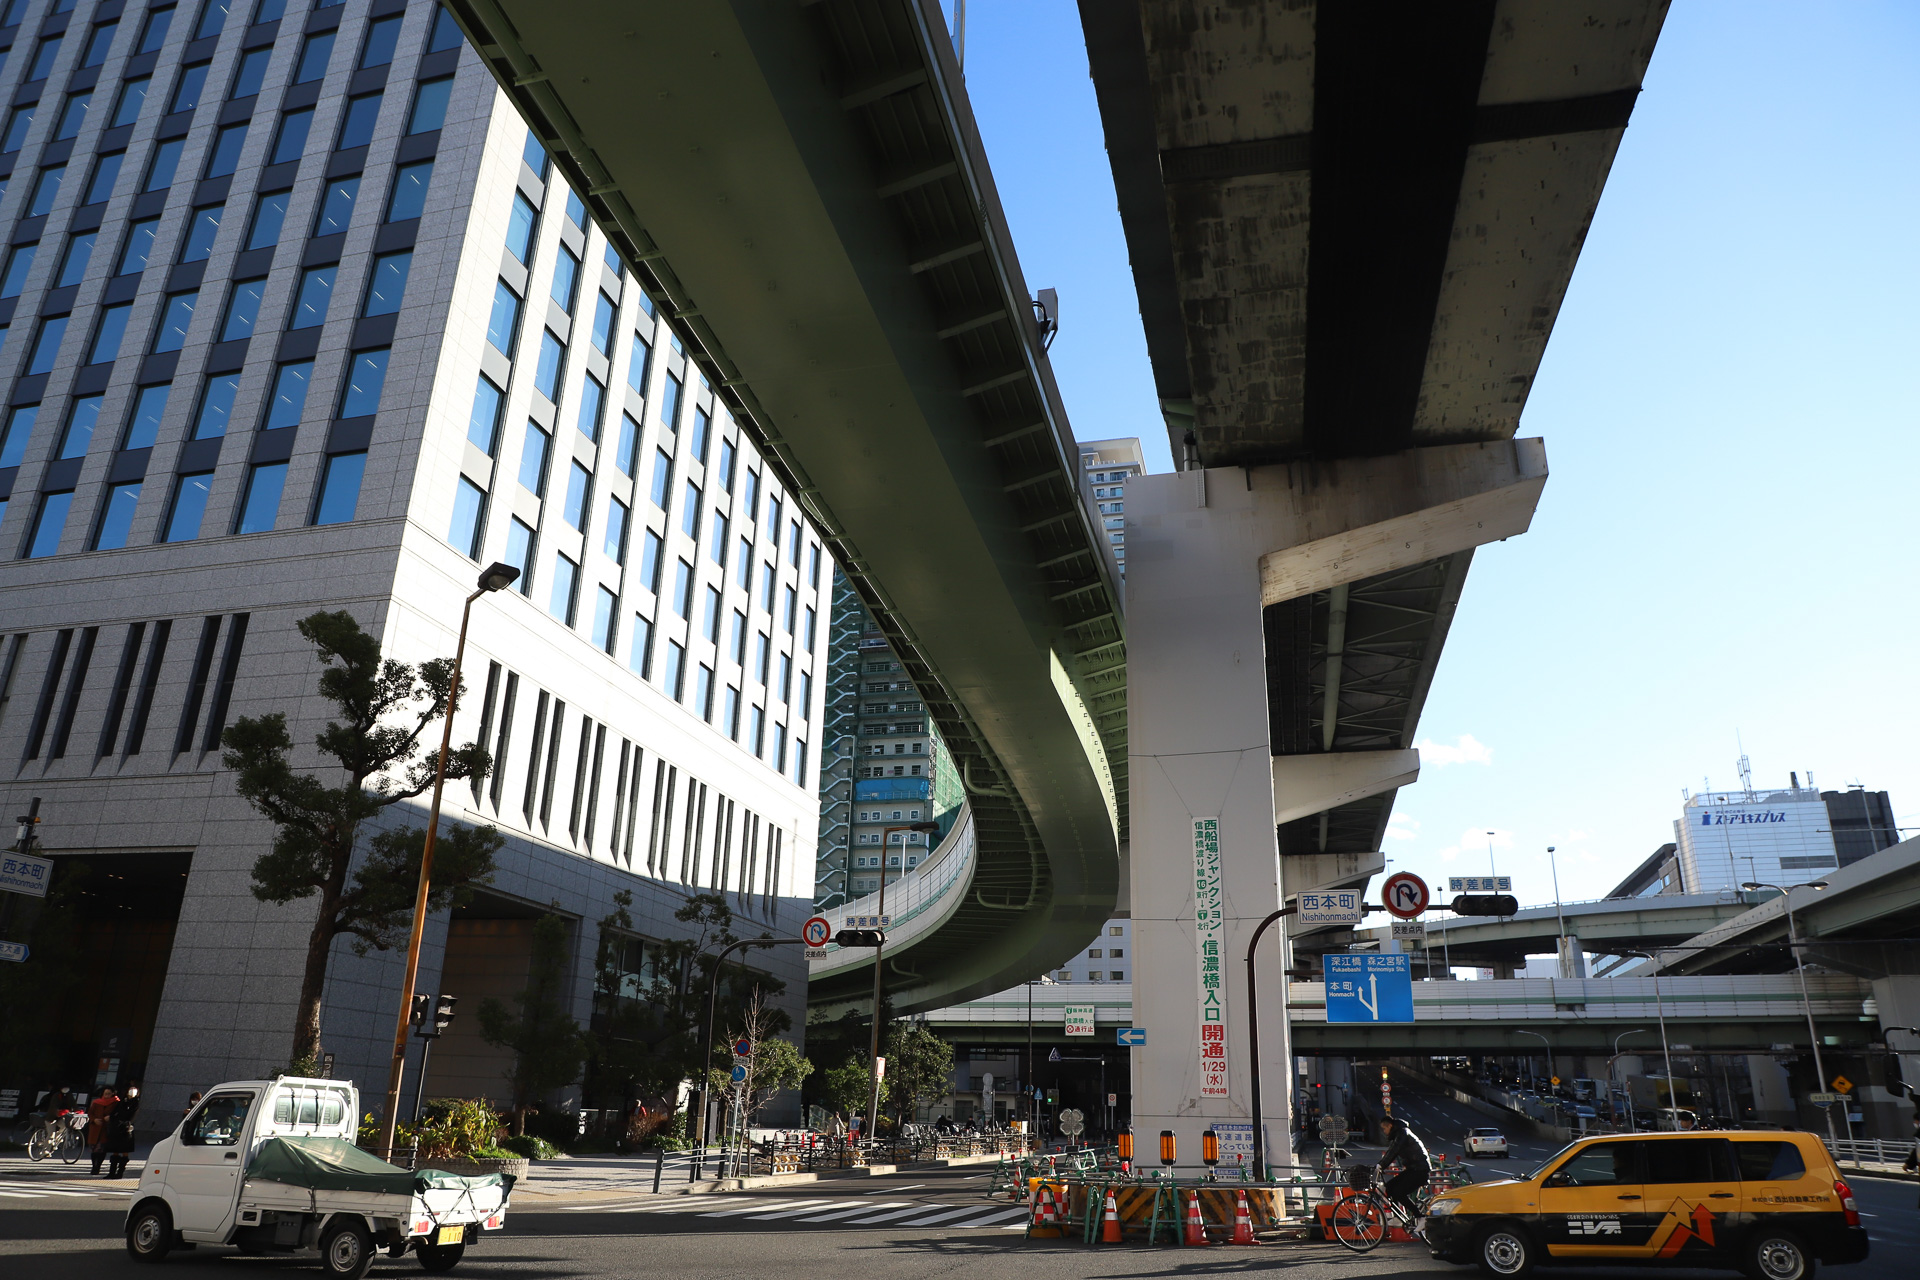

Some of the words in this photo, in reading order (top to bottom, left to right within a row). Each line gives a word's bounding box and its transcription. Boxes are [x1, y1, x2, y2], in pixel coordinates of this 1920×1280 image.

[3, 859, 46, 880] 西本町
[1451, 878, 1510, 890] 時差信号
[1196, 891, 1208, 899] 東行
[1303, 894, 1355, 910] 西本町
[847, 916, 890, 927] 時差信号
[1302, 912, 1358, 921] Nishihonmachi
[1197, 922, 1209, 930] 北行
[1394, 926, 1423, 935] 交差点内
[805, 950, 827, 958] 交差点内
[1331, 956, 1361, 966] 深江橋
[1367, 956, 1405, 966] 森之宮駅
[1330, 981, 1352, 991] 本町
[1202, 1025, 1224, 1058] 開通
[1202, 1061, 1226, 1072] 1/29
[1202, 1087, 1227, 1095] 午前4時
